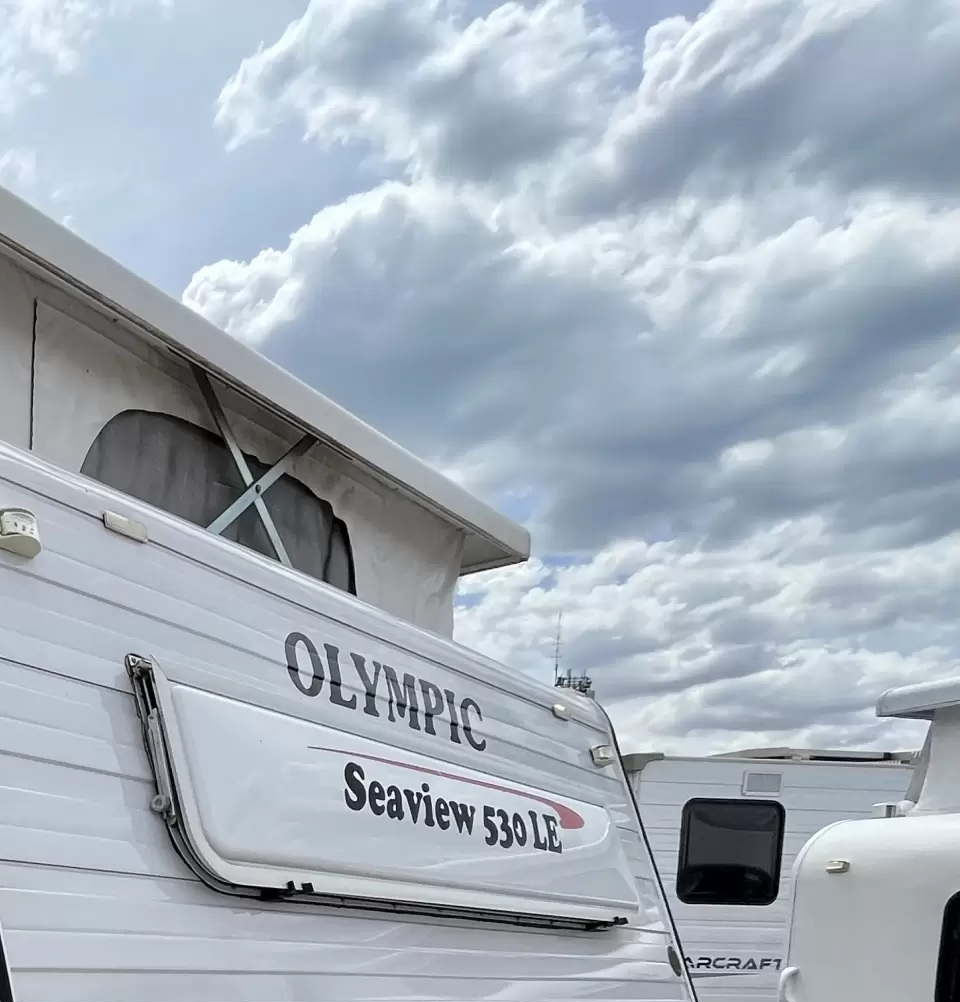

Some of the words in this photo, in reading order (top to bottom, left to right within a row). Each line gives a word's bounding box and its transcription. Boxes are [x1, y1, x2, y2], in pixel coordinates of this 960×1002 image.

[284, 631, 486, 751] OLYMPIC
[344, 762, 476, 835] Seaview
[483, 806, 527, 848] 530
[528, 810, 563, 853] LE
